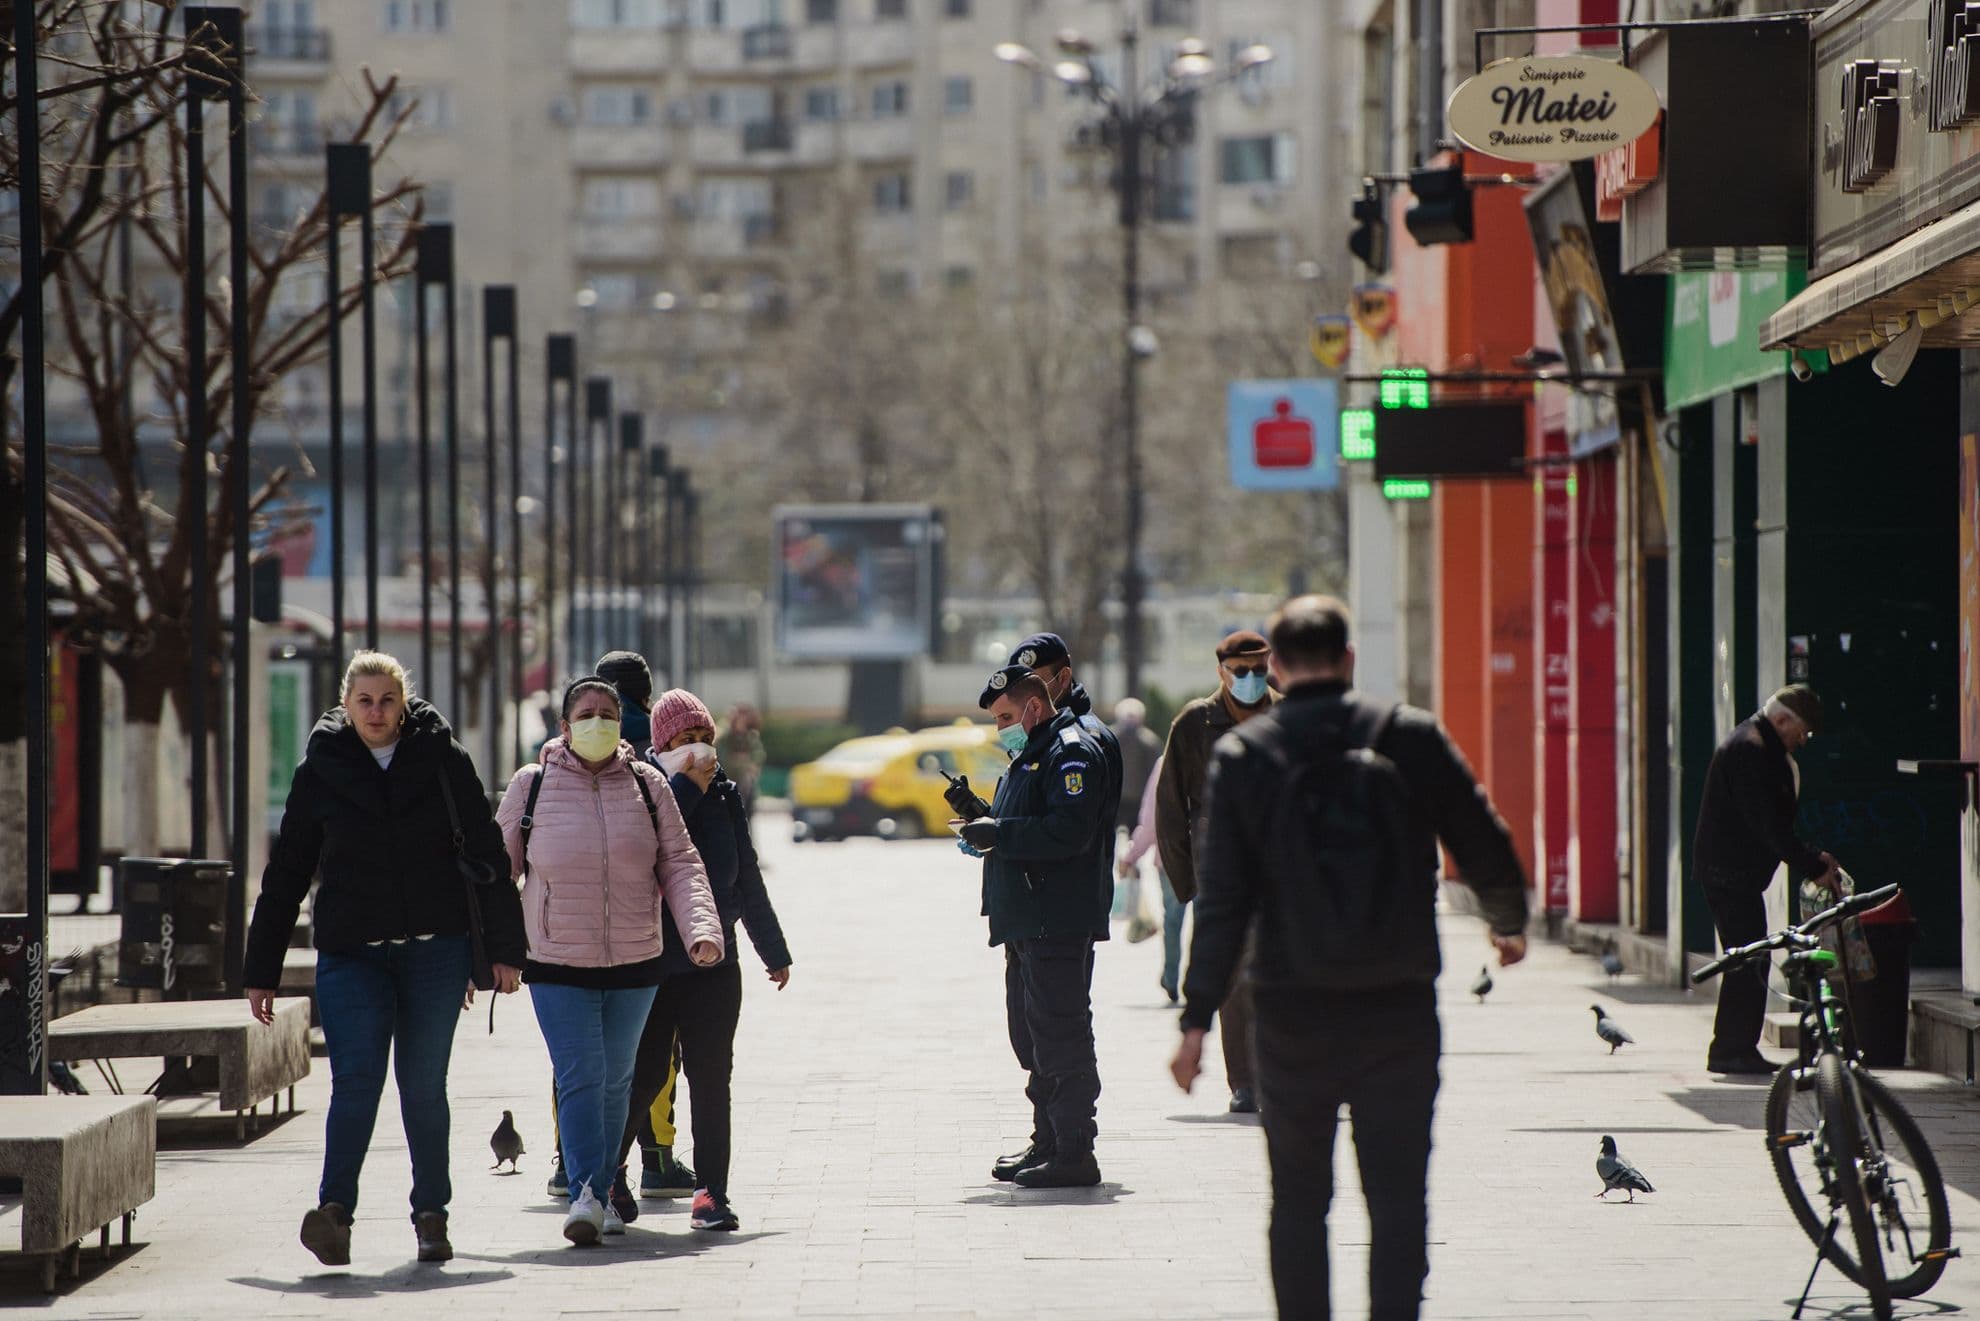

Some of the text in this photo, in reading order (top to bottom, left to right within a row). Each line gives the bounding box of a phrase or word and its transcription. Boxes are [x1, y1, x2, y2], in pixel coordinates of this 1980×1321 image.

[1519, 65, 1586, 85] Simigerie
[1491, 86, 1617, 125] Matei
[1489, 127, 1620, 147] Patiserie Pizzerie
